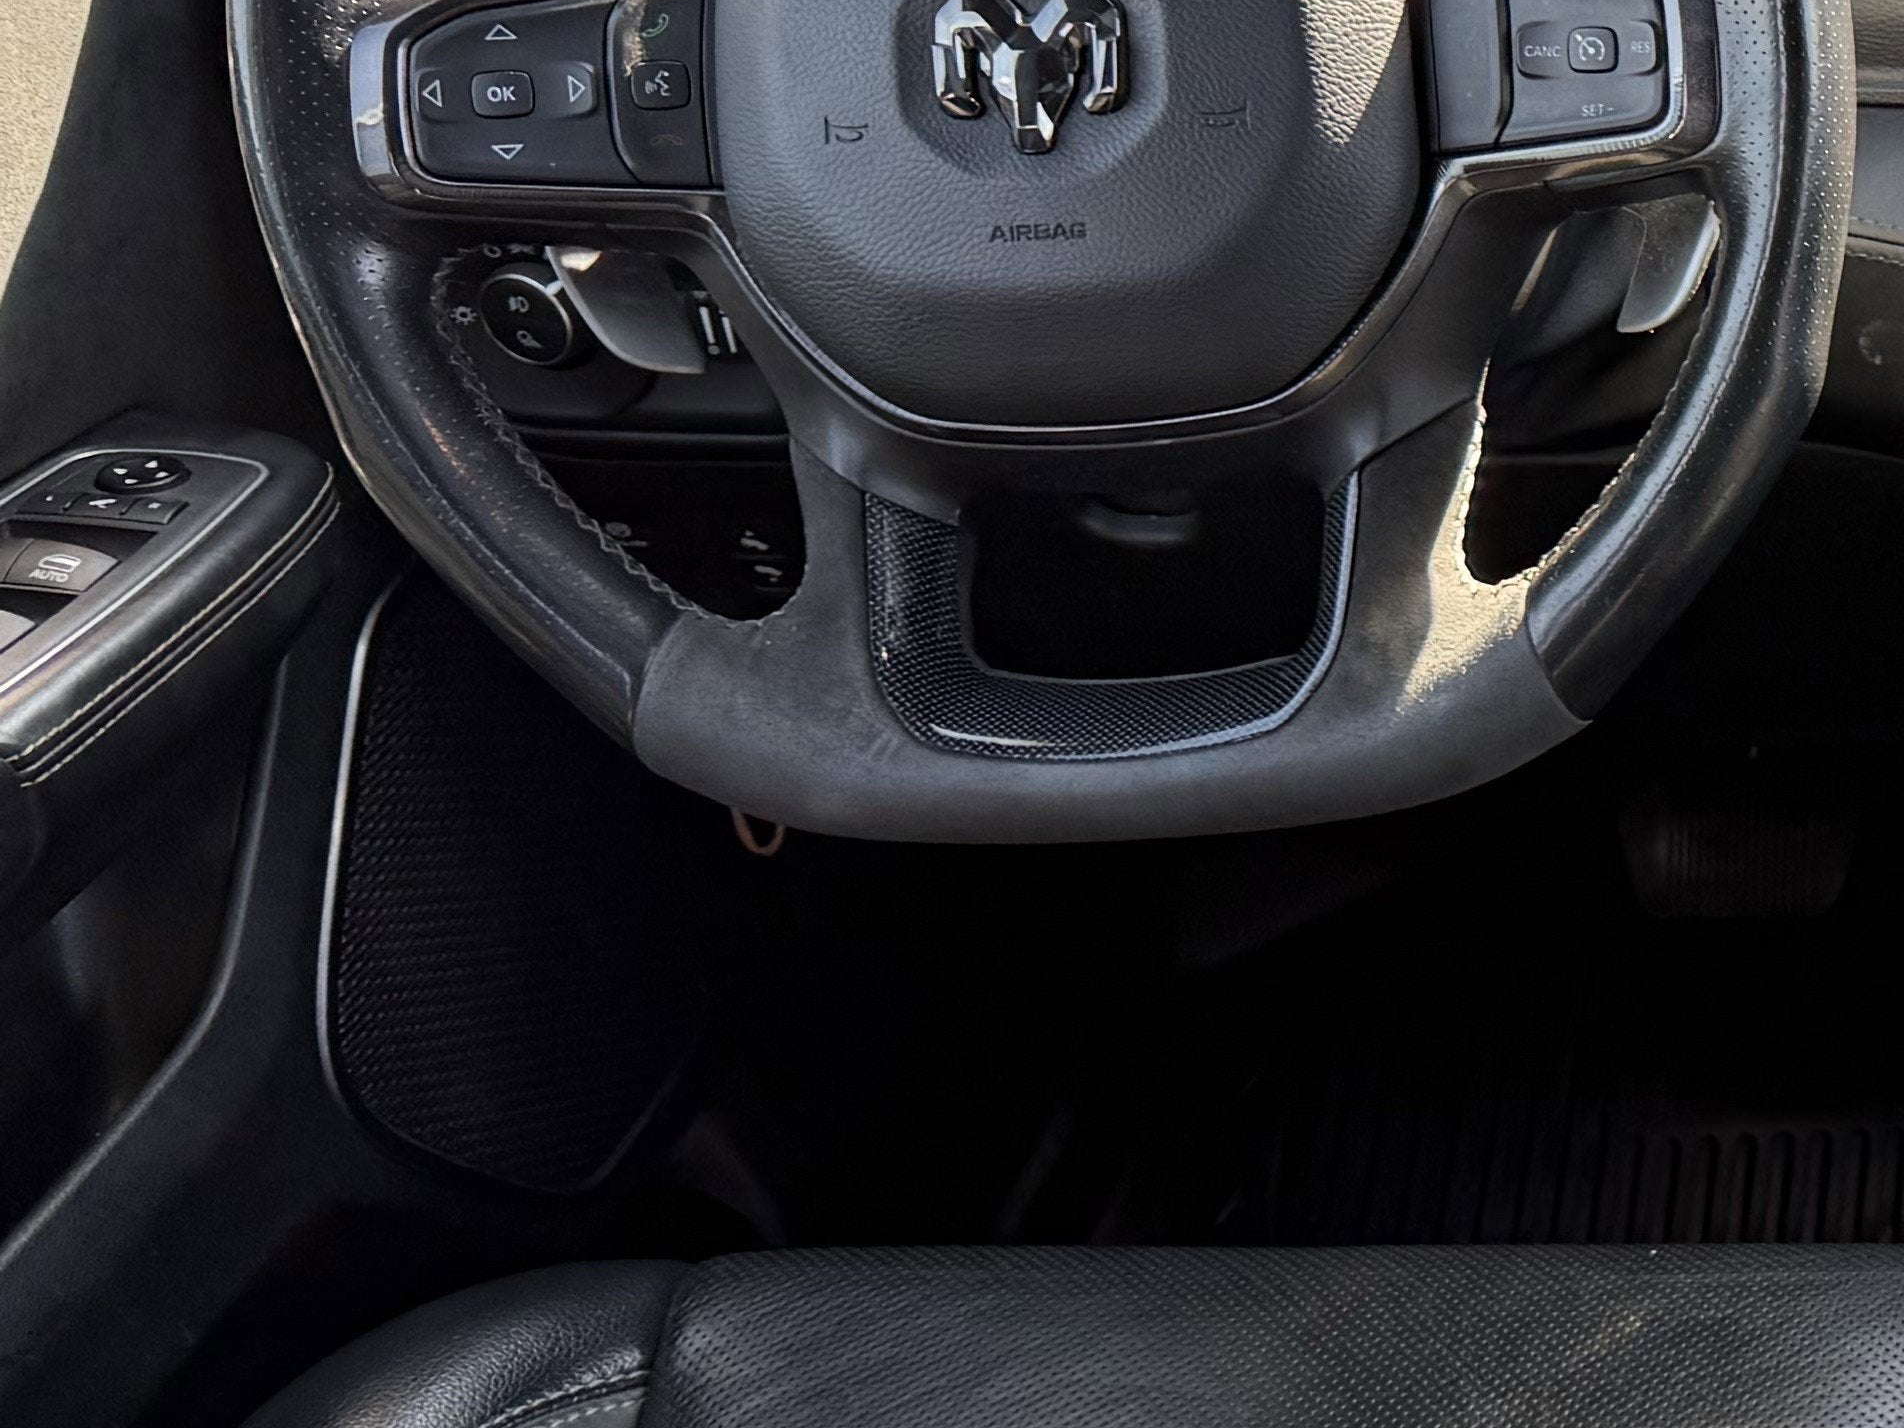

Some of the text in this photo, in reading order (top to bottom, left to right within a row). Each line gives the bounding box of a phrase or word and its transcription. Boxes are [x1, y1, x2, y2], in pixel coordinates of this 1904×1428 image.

[1524, 44, 1562, 58] CANC
[1631, 41, 1651, 54] RES
[486, 86, 517, 102] OK
[988, 221, 1087, 243] AIRBAG
[28, 569, 69, 583] AUTO
